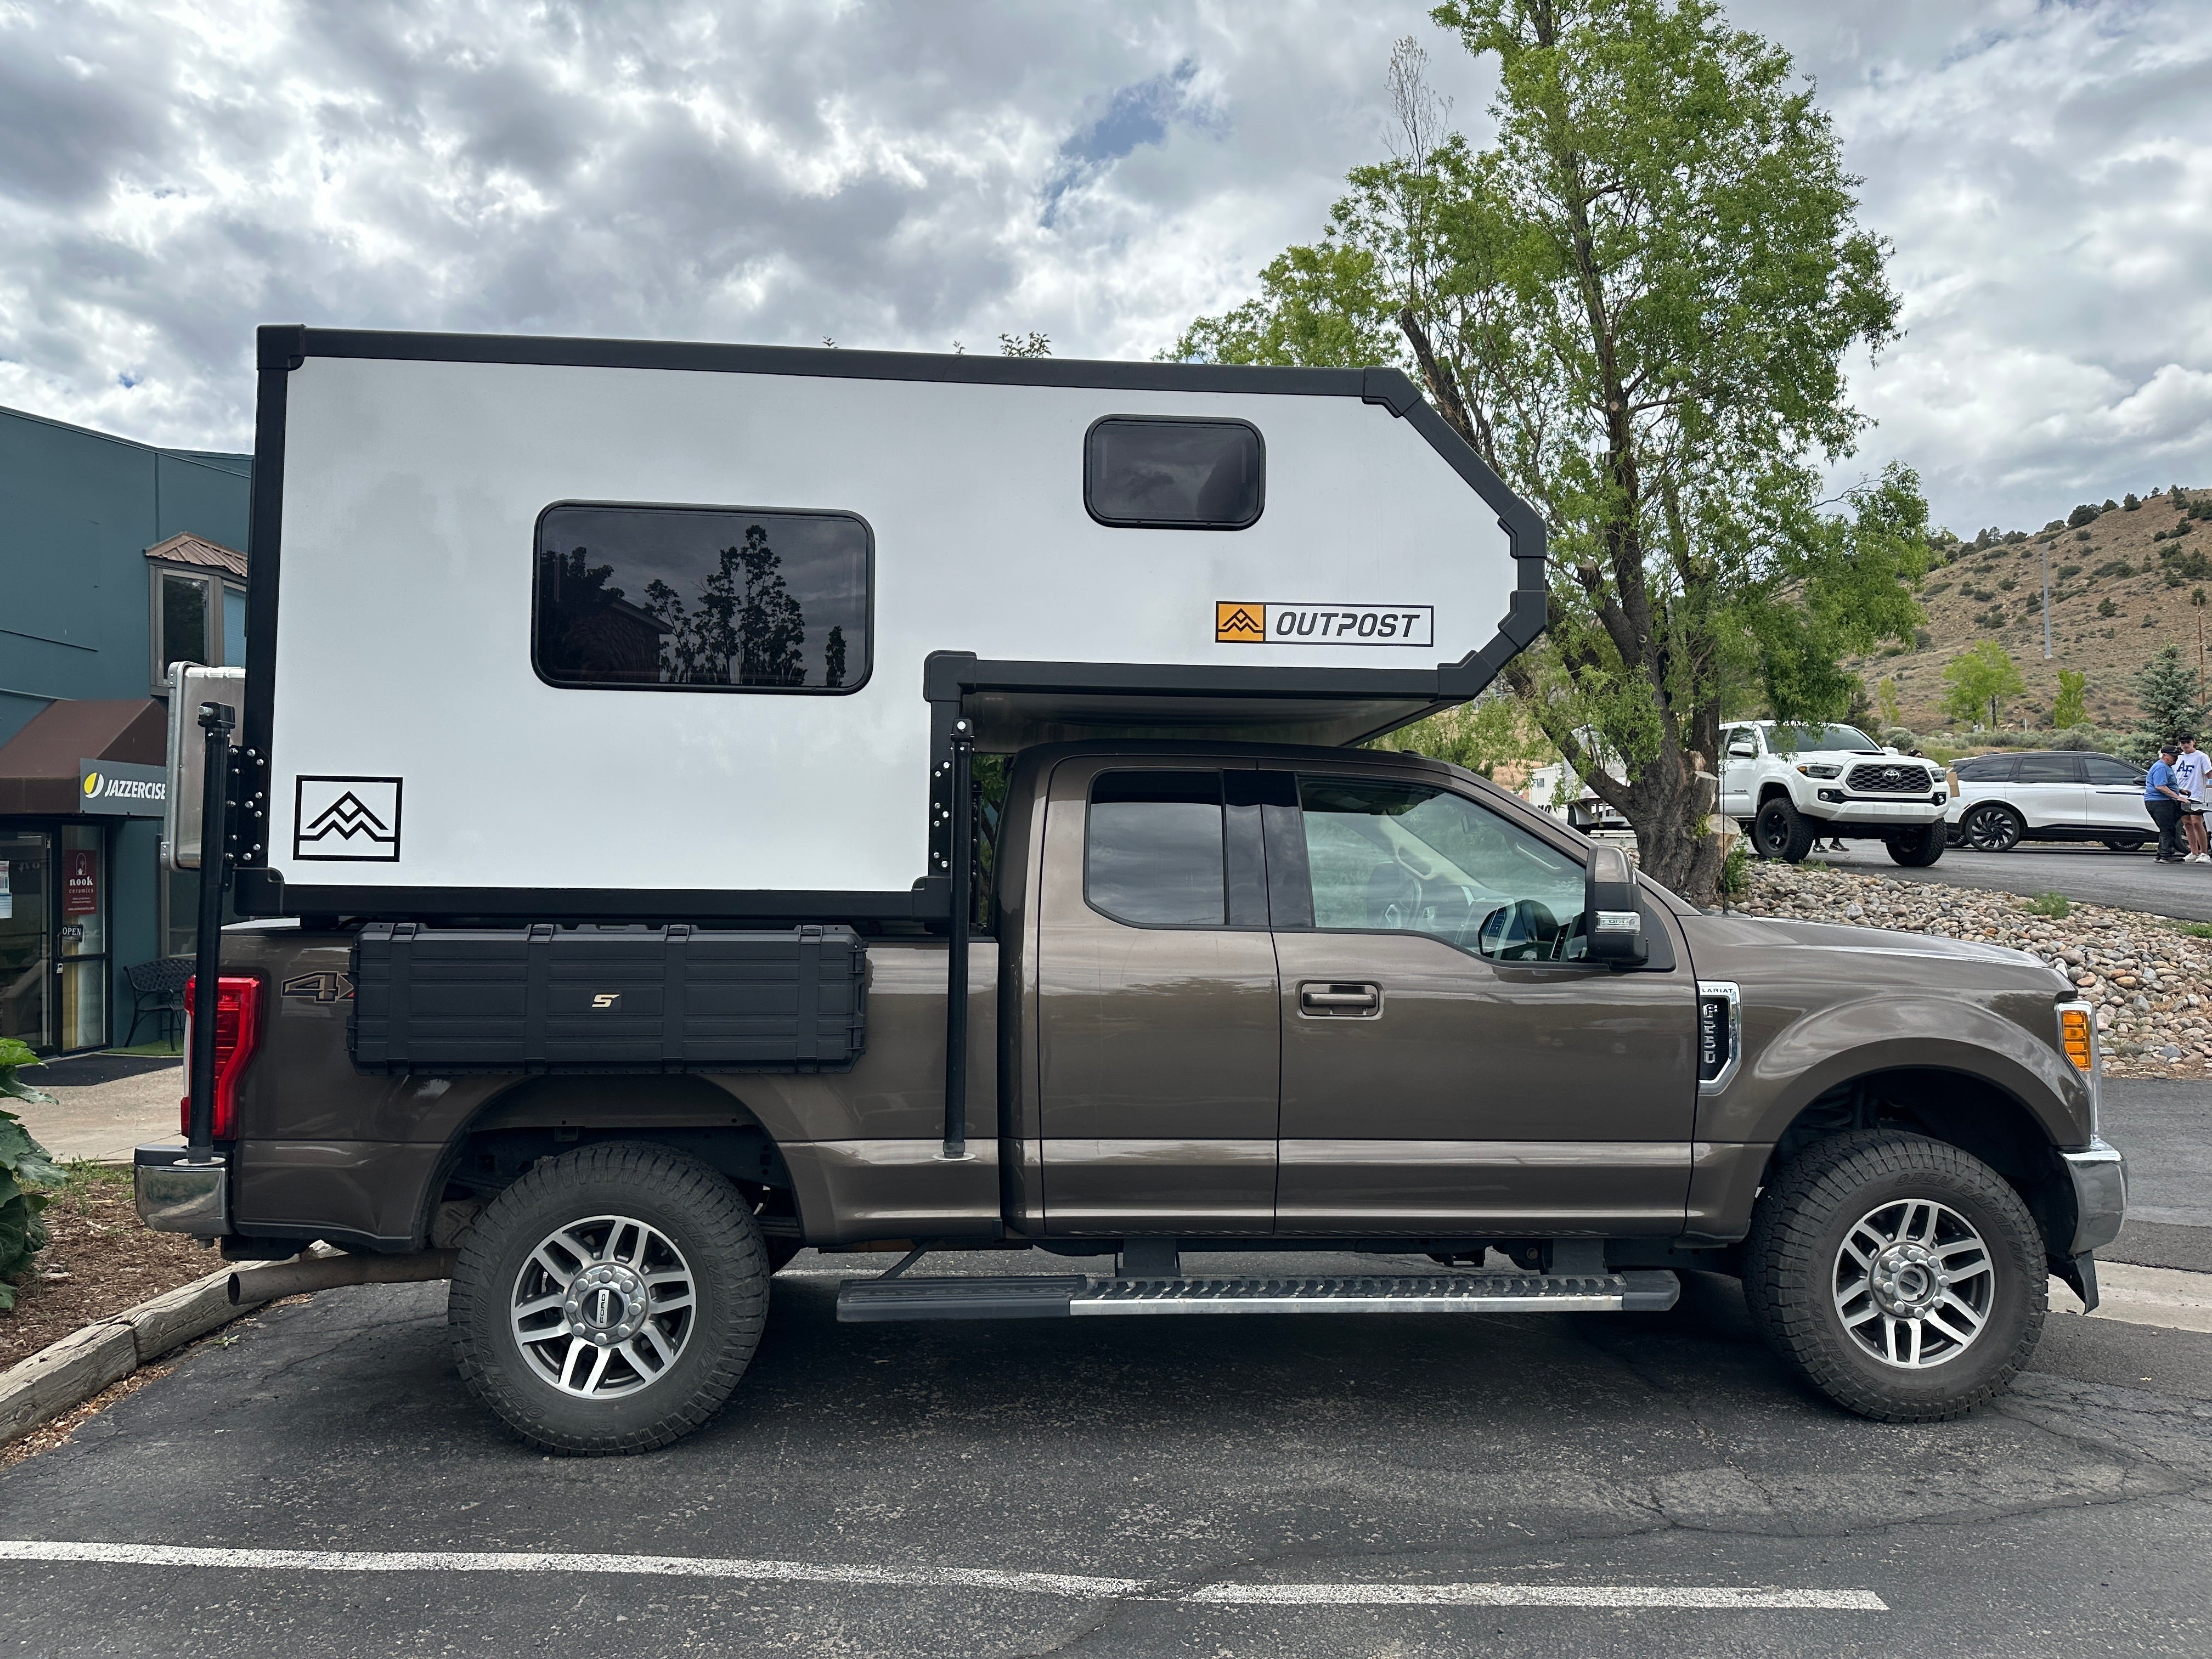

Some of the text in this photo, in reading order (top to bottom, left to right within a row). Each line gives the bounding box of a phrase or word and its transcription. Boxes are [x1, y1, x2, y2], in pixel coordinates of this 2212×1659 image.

[1276, 612, 1420, 637] OUTPOST
[2177, 760, 2195, 777] AF
[104, 779, 166, 800] JAZZERCISE
[46, 839, 50, 848] F
[69, 876, 93, 886] nook
[62, 927, 82, 936] OPEN
[591, 994, 620, 1007] S
[1895, 1172, 1954, 1188] OPEN
[1954, 1183, 2016, 1235] RANGE
[658, 1204, 710, 1248] OPEN
[701, 1253, 725, 1336] RANGE
[475, 1286, 501, 1367] RANGE
[490, 1373, 546, 1418] OPEN
